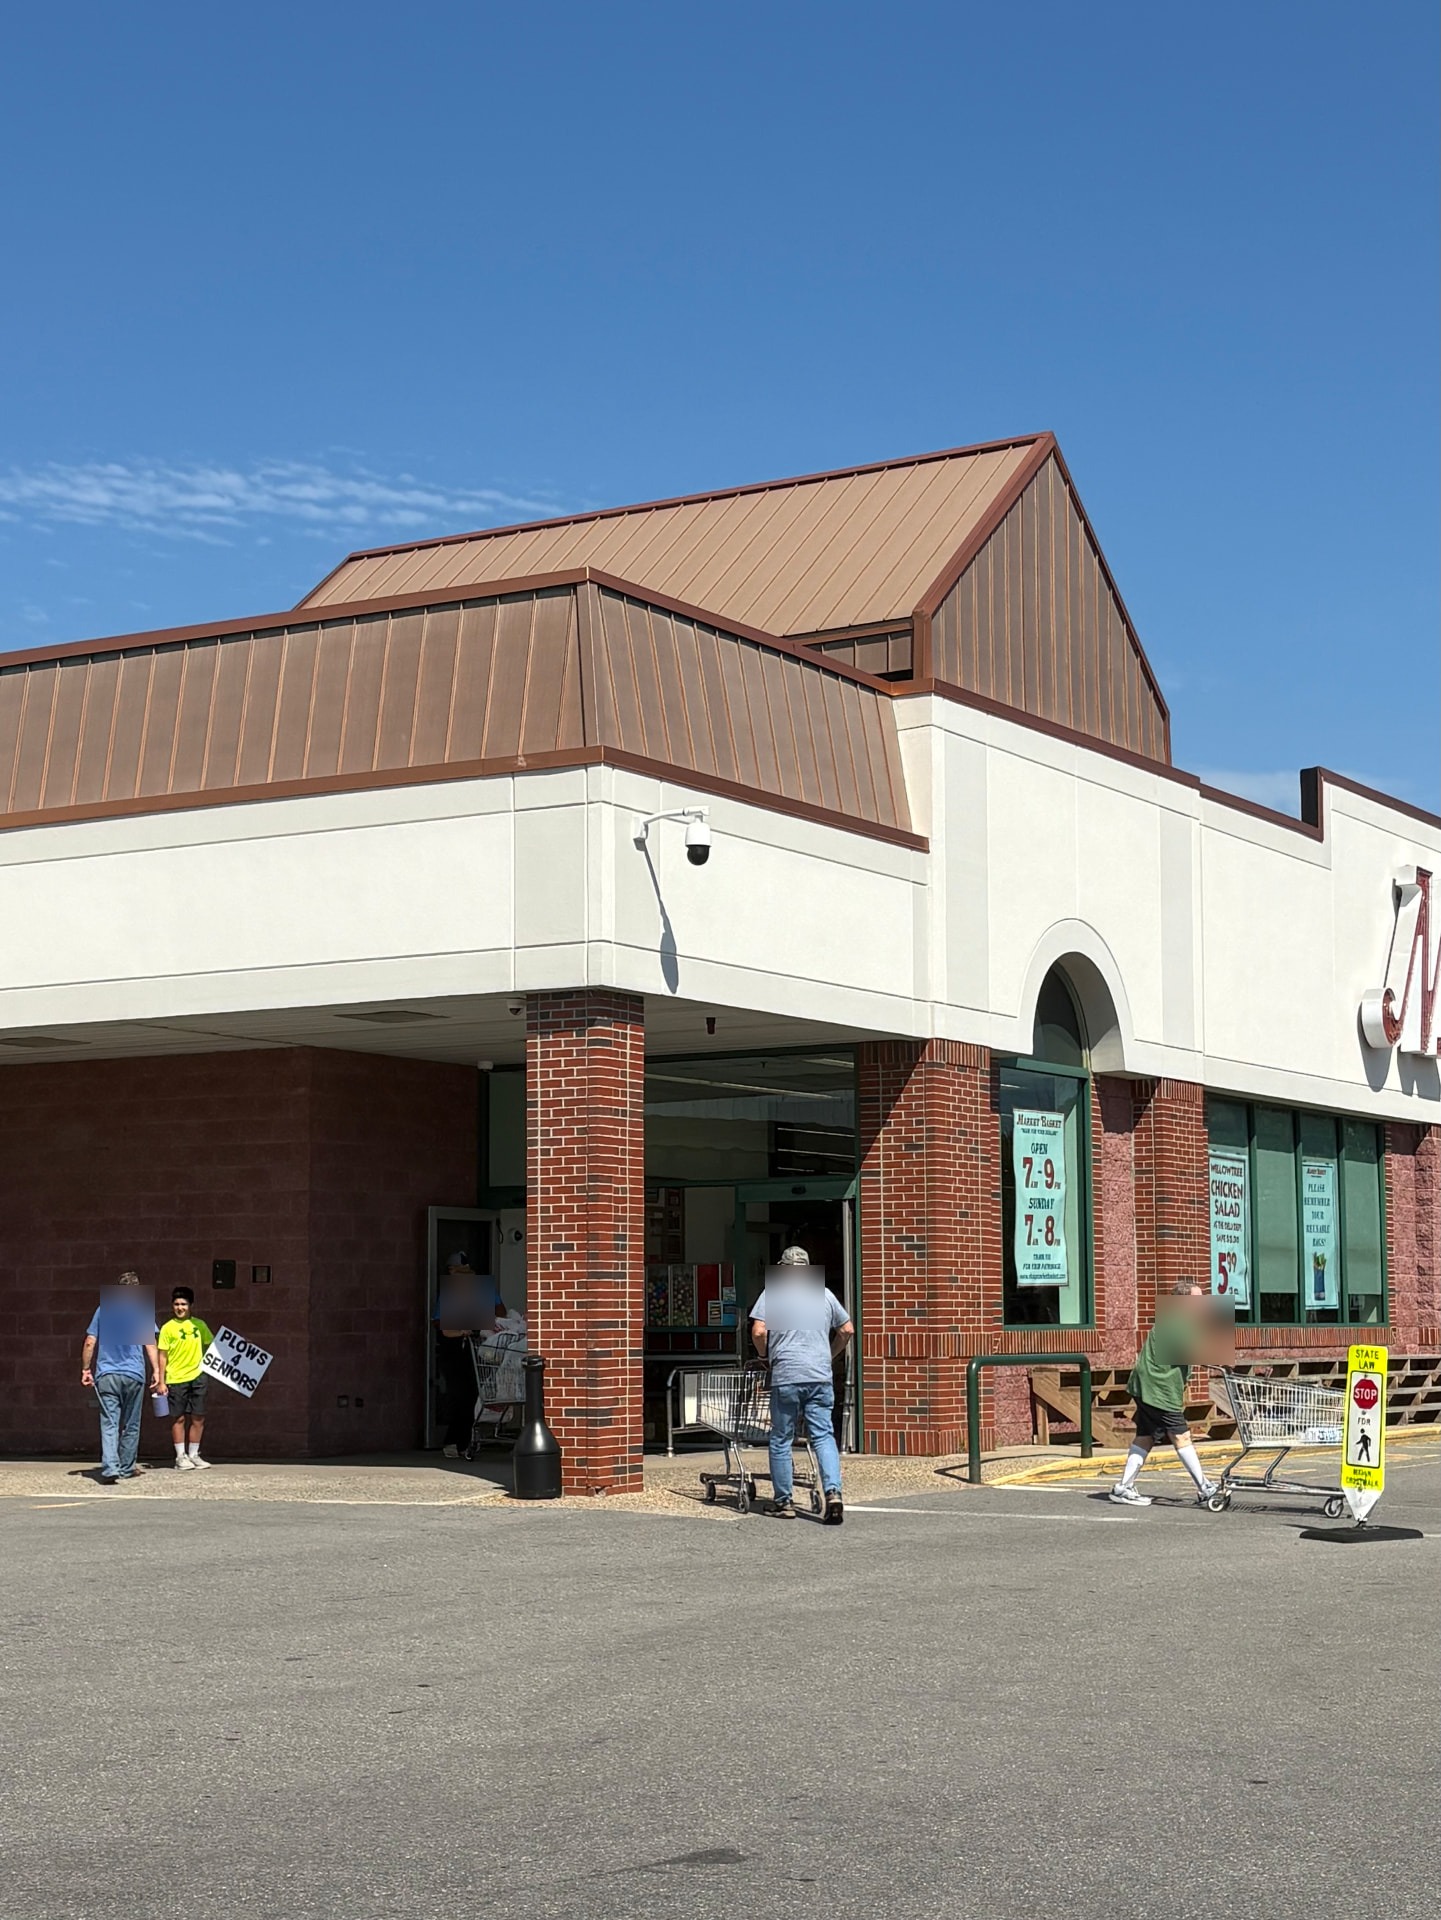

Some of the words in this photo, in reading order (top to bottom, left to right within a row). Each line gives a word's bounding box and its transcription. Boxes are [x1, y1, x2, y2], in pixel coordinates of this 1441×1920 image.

[1030, 1142, 1048, 1154] OPEN
[1211, 1180, 1243, 1200] CHICKEN
[1028, 1198, 1055, 1209] SUNDAY
[1214, 1198, 1240, 1218] SALAD
[220, 1330, 268, 1366] PLOWS
[231, 1354, 242, 1366] 4
[1356, 1350, 1379, 1360] STATE
[1359, 1361, 1375, 1370] LAW
[203, 1353, 257, 1391] SENIORS
[1354, 1388, 1377, 1400] STOP
[1357, 1417, 1371, 1425] FOR
